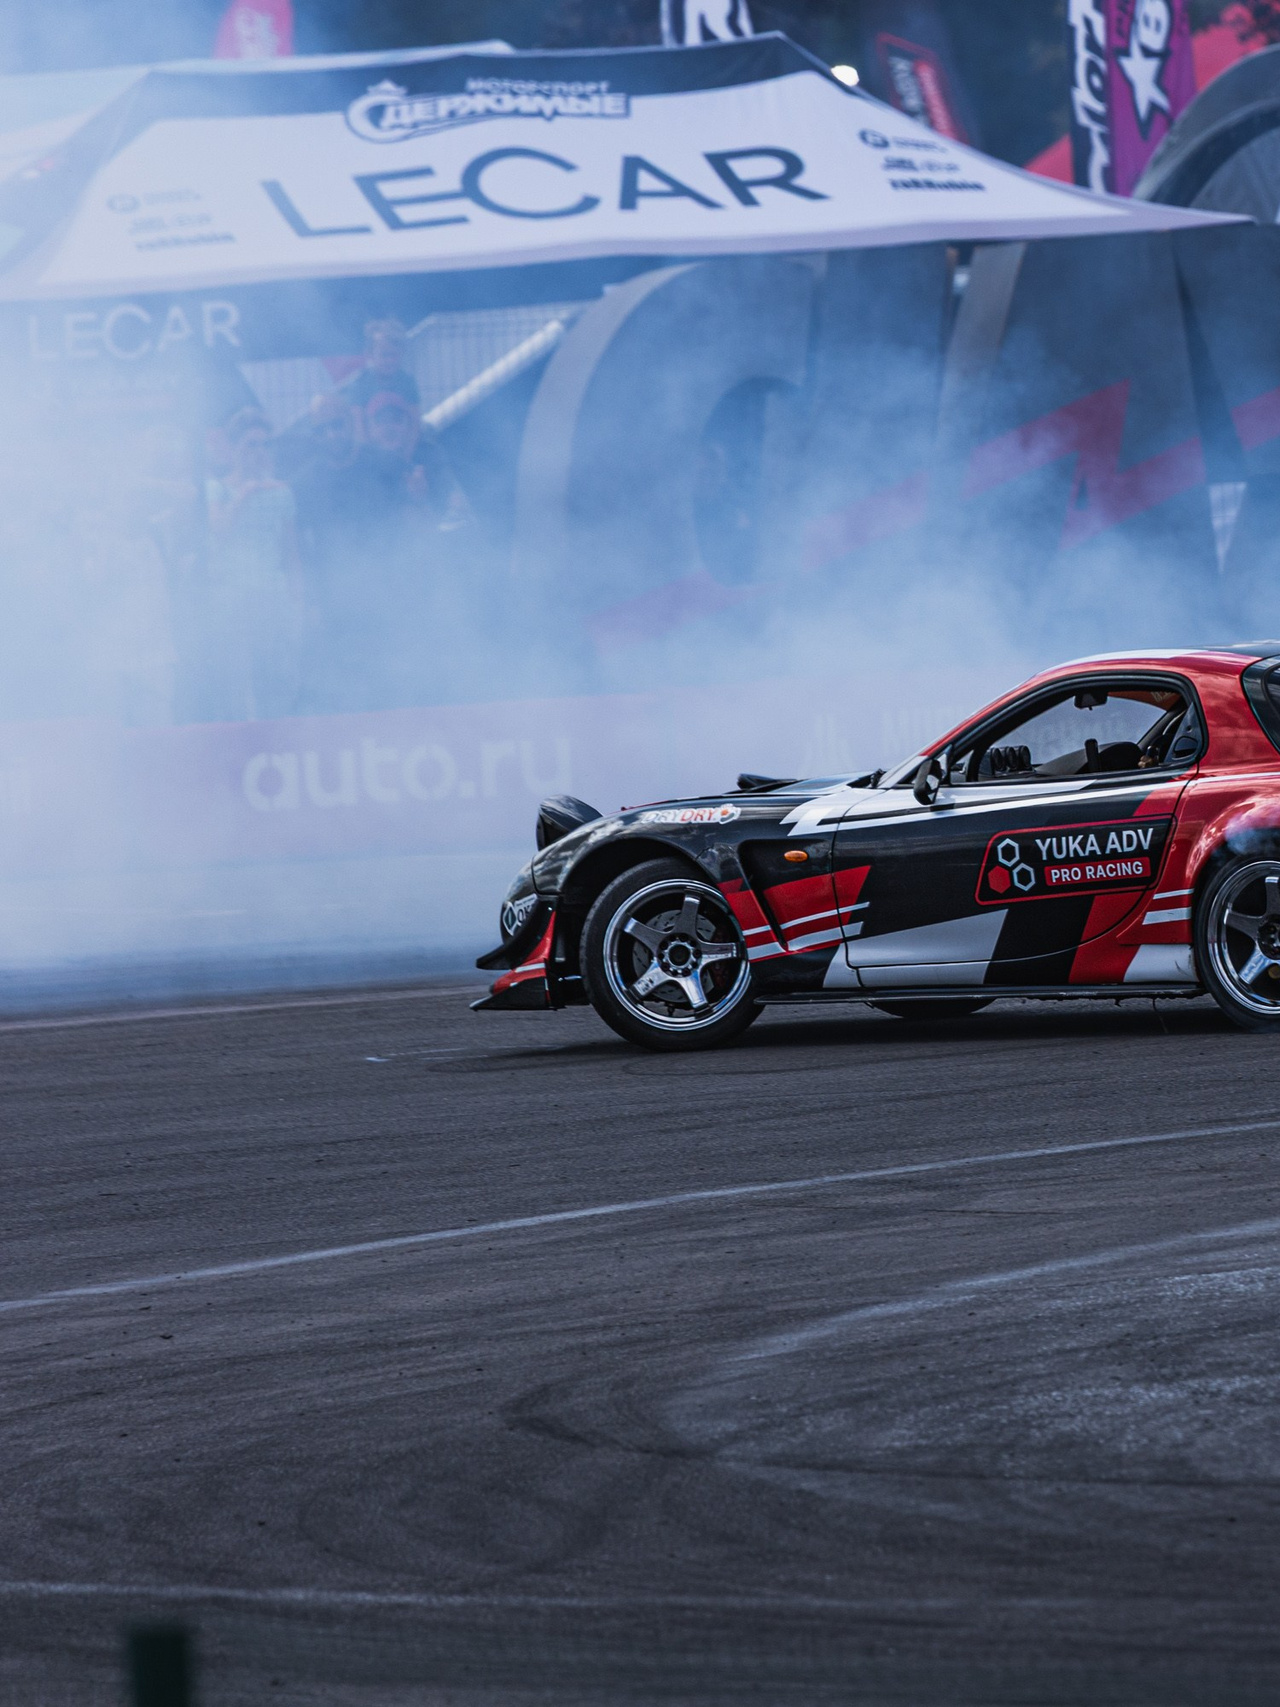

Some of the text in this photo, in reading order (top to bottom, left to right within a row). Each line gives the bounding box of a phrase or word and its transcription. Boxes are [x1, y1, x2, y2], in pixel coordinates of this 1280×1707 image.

[260, 146, 832, 238] LECAR
[28, 301, 242, 360] LECAR
[242, 736, 573, 811] auto.ru
[1034, 827, 1154, 861] YUKA ADV
[1050, 860, 1143, 883] PRO RACING
